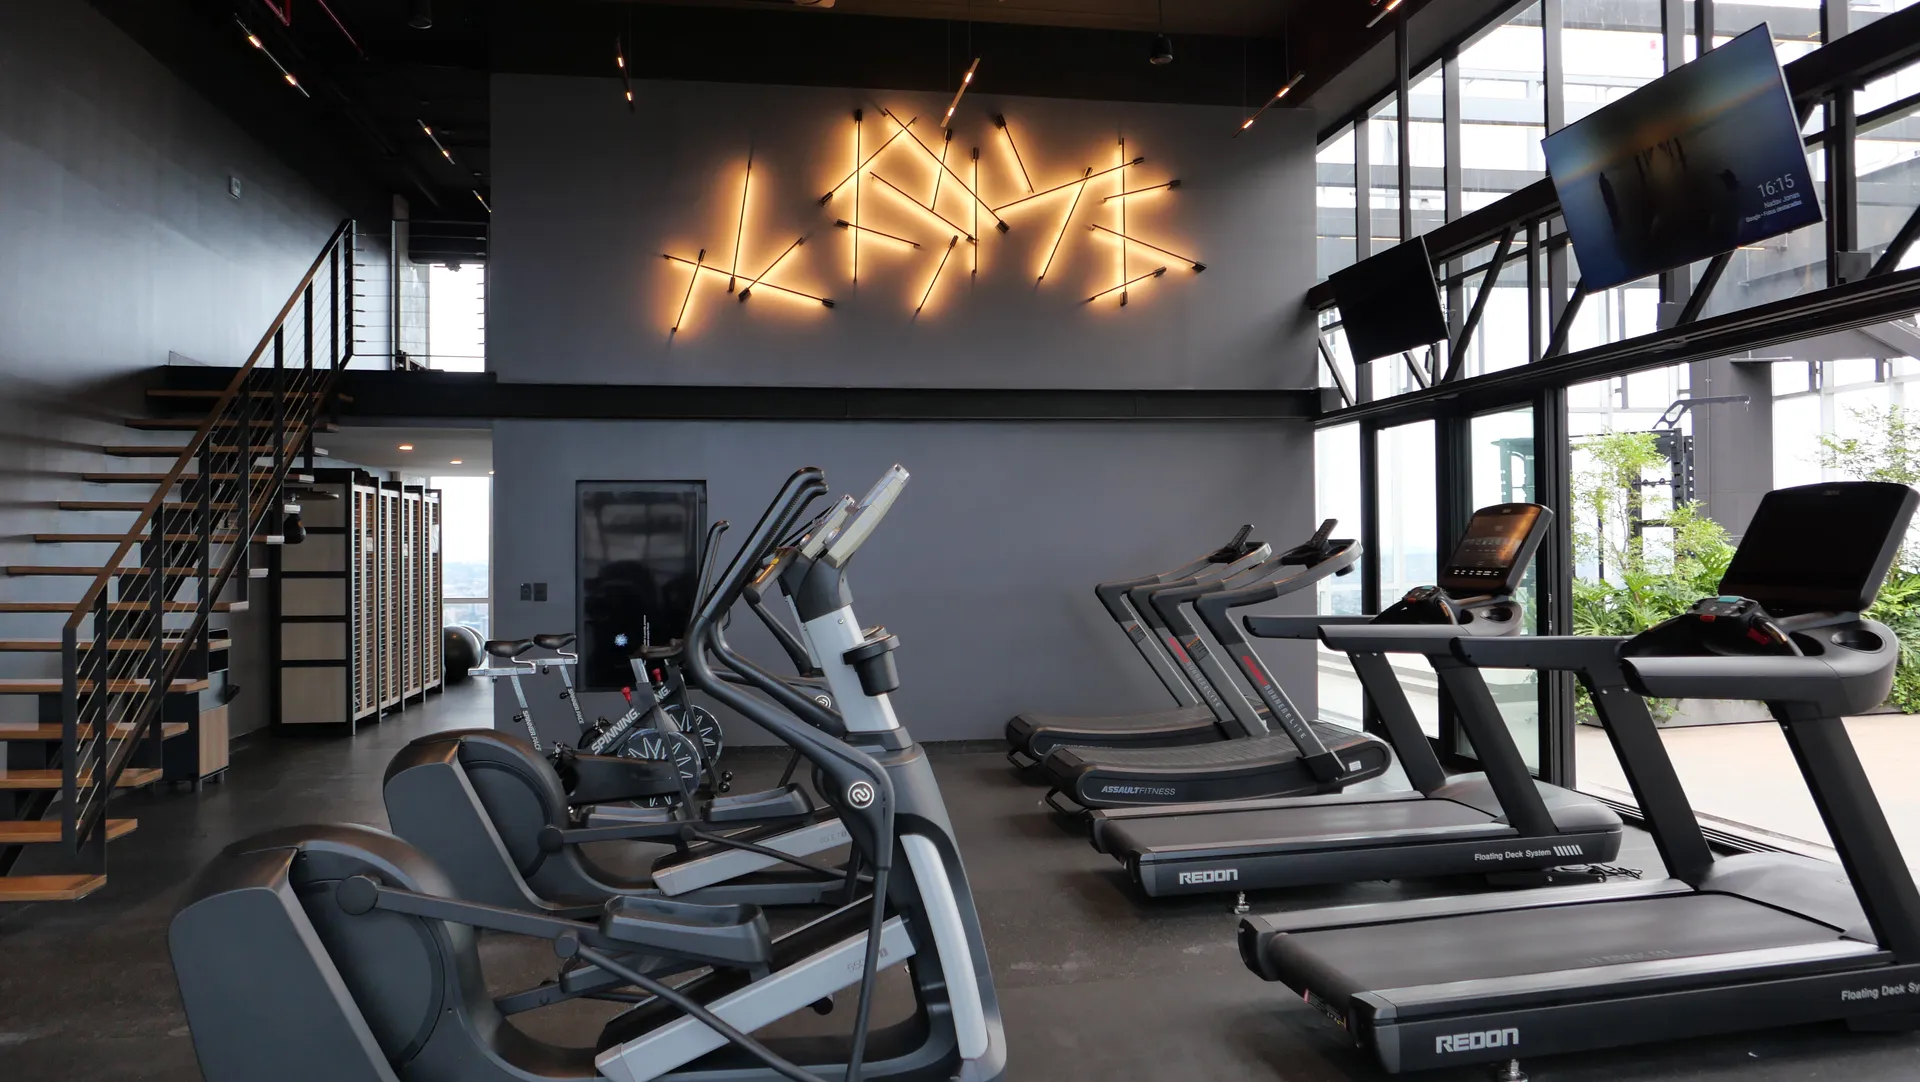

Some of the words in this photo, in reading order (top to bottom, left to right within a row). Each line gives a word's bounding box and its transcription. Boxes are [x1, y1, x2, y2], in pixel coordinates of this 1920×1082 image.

[1757, 173, 1795, 198] 16:15
[522, 710, 537, 736] SPINNER
[1474, 852, 1504, 861] Floating
[1505, 851, 1524, 859] Deck
[1525, 849, 1552, 859] System
[1179, 868, 1239, 885] REDON
[1841, 988, 1879, 1001] Floating
[1881, 984, 1905, 996] Deck
[1435, 1027, 1520, 1054] REDON
